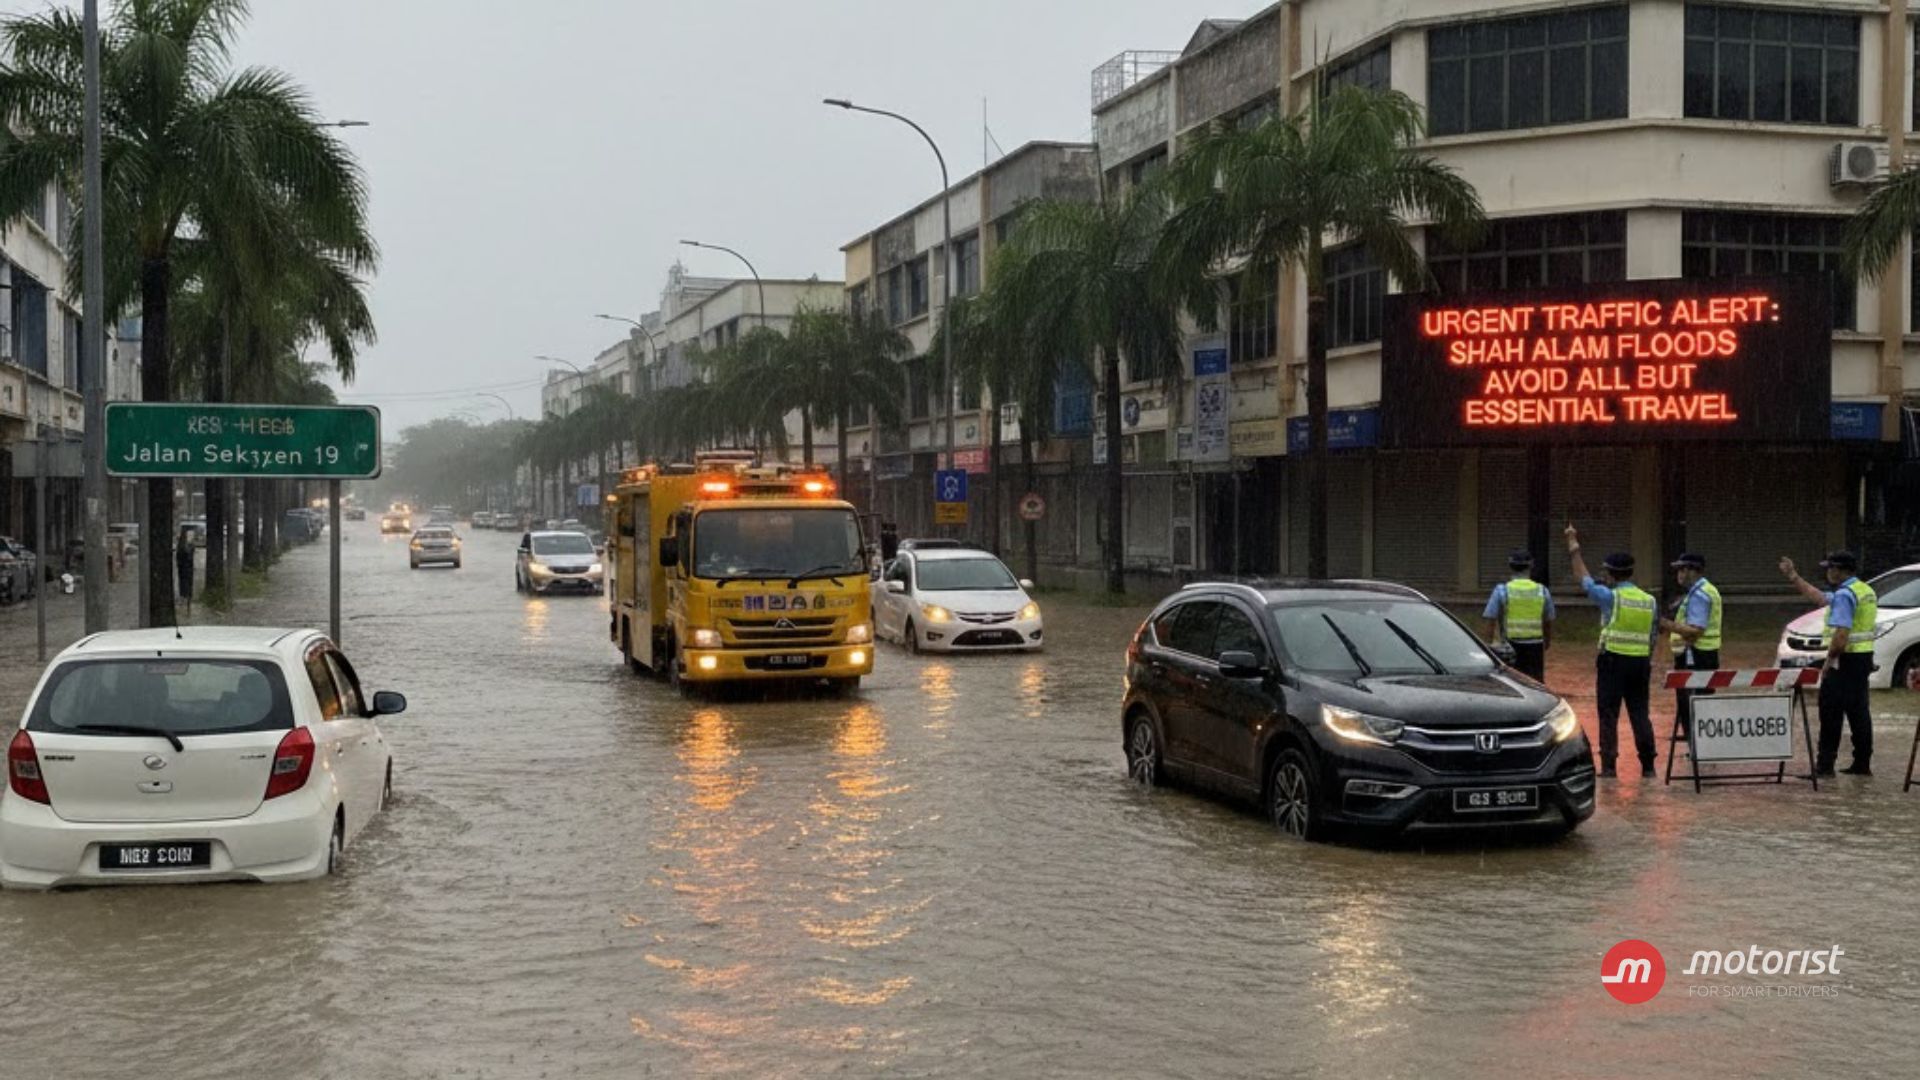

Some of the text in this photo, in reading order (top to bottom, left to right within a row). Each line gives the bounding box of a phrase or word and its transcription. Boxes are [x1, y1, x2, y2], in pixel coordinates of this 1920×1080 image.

[1423, 296, 1780, 337] URGENT TRAFFIC ALERT:
[1450, 329, 1738, 365] SHAH ALAM FLOODS
[1485, 364, 1698, 394] AVOID ALL BUT
[1465, 393, 1738, 425] ESSENTIAL TRAVEL
[123, 442, 191, 463] Jalan
[315, 445, 339, 465] 19
